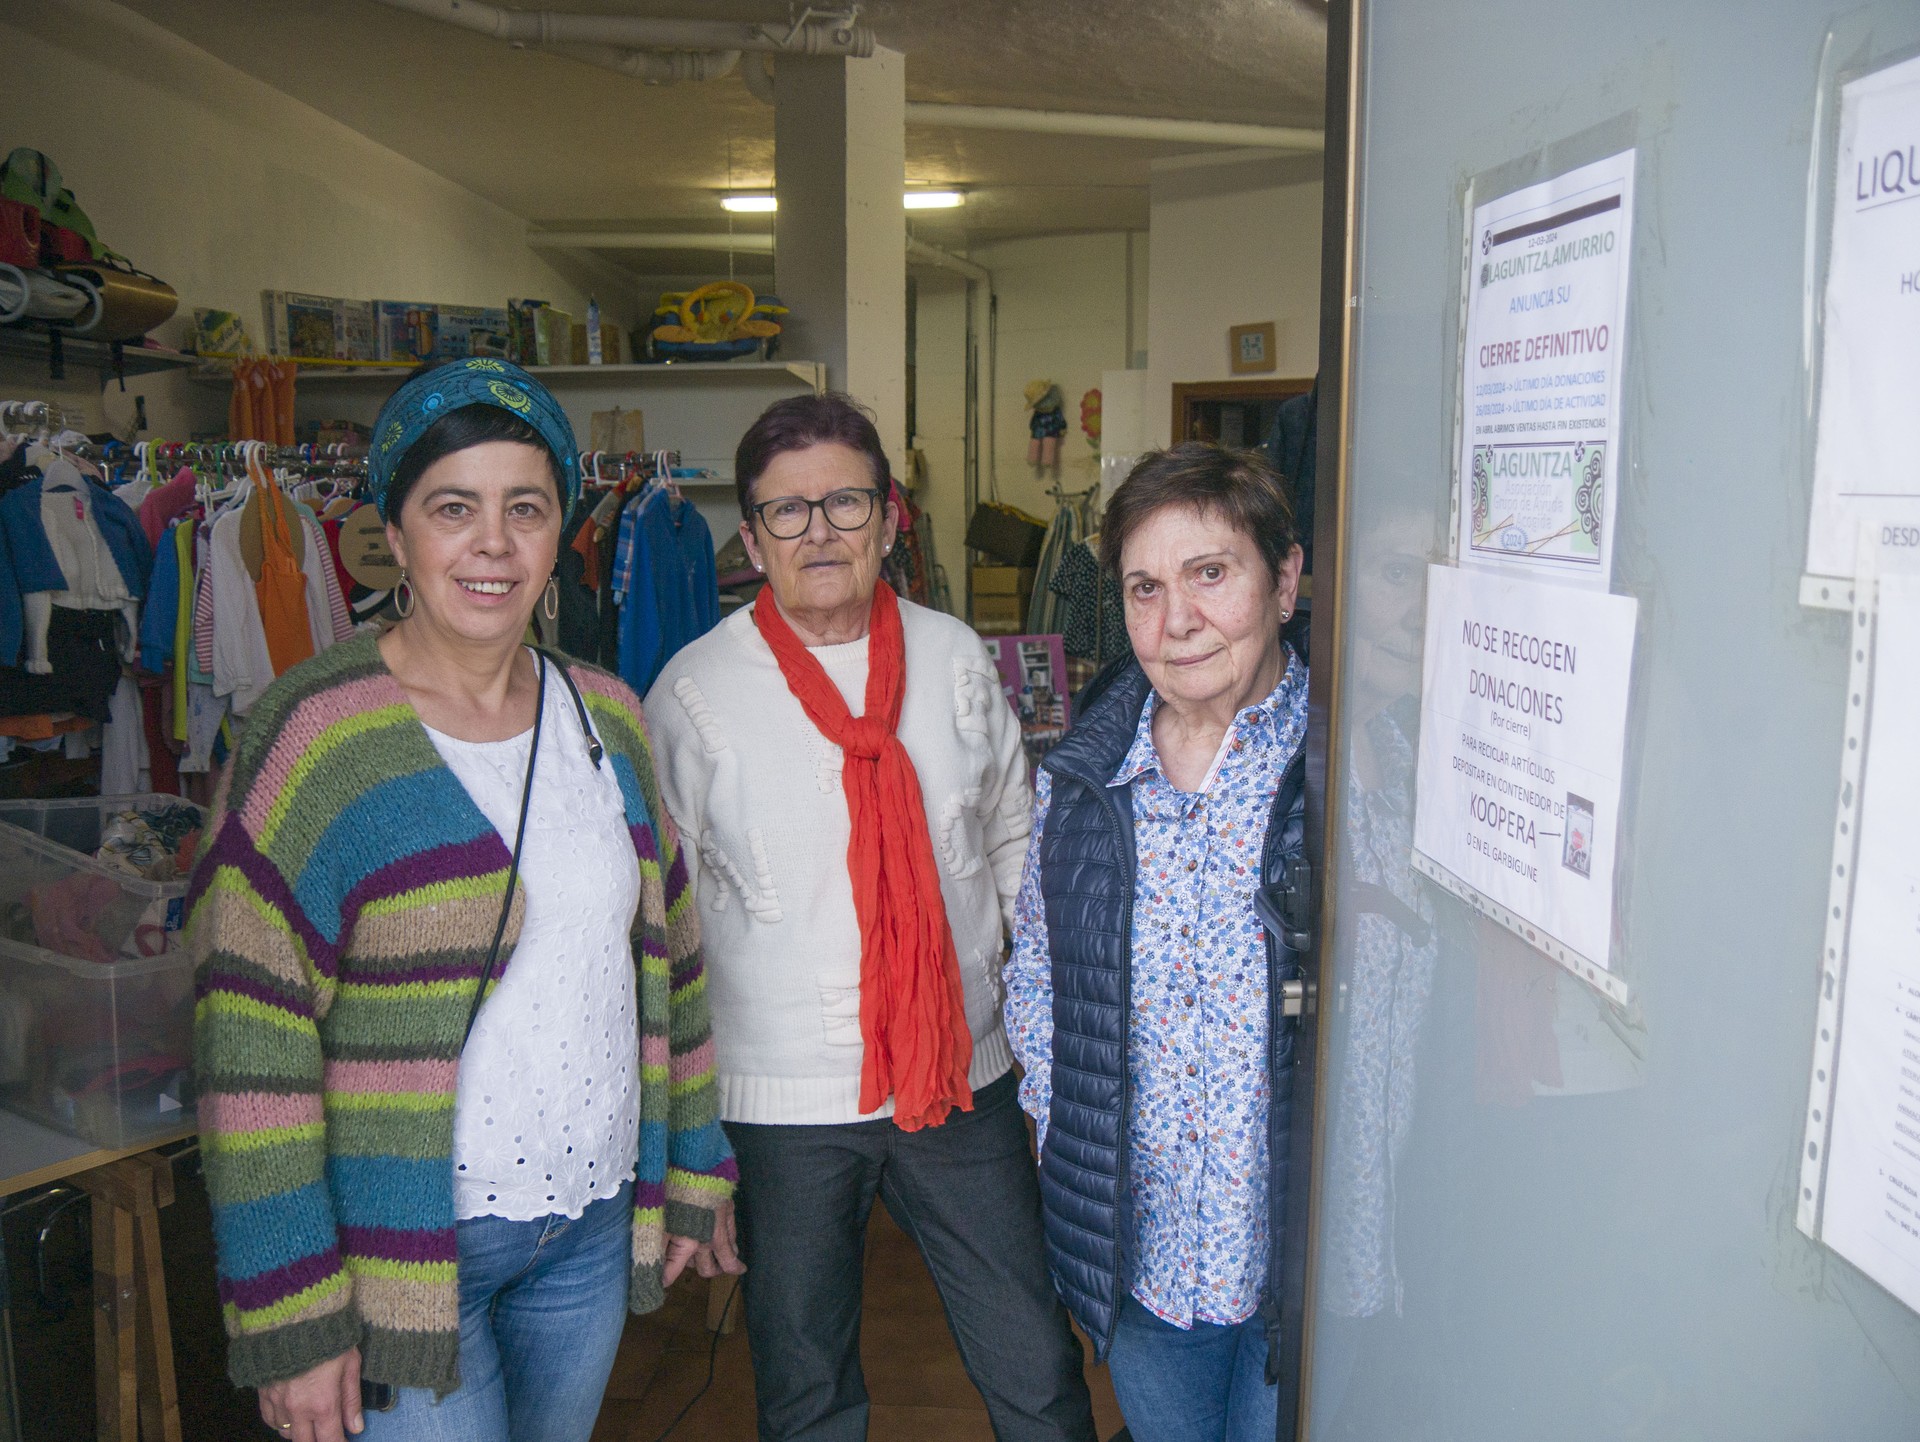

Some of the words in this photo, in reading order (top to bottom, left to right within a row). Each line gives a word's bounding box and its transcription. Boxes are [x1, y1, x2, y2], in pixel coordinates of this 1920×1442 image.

[1528, 232, 1558, 248] 12-03-2024
[1488, 230, 1615, 284] LAGUNTZA.AMURRIO
[1509, 289, 1555, 313] ANUNCIA
[1557, 285, 1571, 303] SU
[1480, 340, 1521, 368] CIERRE
[1525, 324, 1609, 362] DEFINITIVO
[1513, 375, 1540, 391] ÚLTIMO
[1540, 374, 1553, 389] DÍA
[1554, 370, 1606, 387] DONACIONES
[1512, 398, 1539, 413] ÚLTIMO
[1539, 396, 1553, 411] DÍA
[1554, 398, 1564, 410] DE
[1565, 394, 1606, 409] ACTIVIDAD
[1516, 422, 1536, 433] VENTAS
[1537, 420, 1556, 431] HASTA
[1557, 420, 1567, 430] FIN
[1569, 418, 1606, 429] EXISTENCIAS
[1493, 451, 1572, 478] LAGUNTZA
[1520, 497, 1531, 510] de
[1505, 533, 1522, 547] 2024
[1882, 526, 1920, 547] DESD
[1462, 619, 1481, 648] NO
[1483, 625, 1498, 654] SE
[1501, 629, 1577, 675] RECOGEN
[1469, 669, 1563, 725] DONACIONES
[1490, 710, 1504, 728] (Por
[1505, 717, 1532, 741] cierre)
[1461, 733, 1477, 752] PARA
[1478, 739, 1510, 766] RECICLAR
[1510, 752, 1556, 785] ARTÍCULOS
[1452, 755, 1486, 784] DEPOSITAR
[1486, 772, 1497, 789] EN
[1498, 777, 1552, 812] CONTENEDOR
[1553, 802, 1565, 820] DE
[1470, 791, 1537, 849] KOOPERA
[1466, 832, 1472, 846] O
[1472, 835, 1482, 851] EN
[1482, 840, 1490, 856] EL
[1492, 847, 1538, 883] GARBIGUNE
